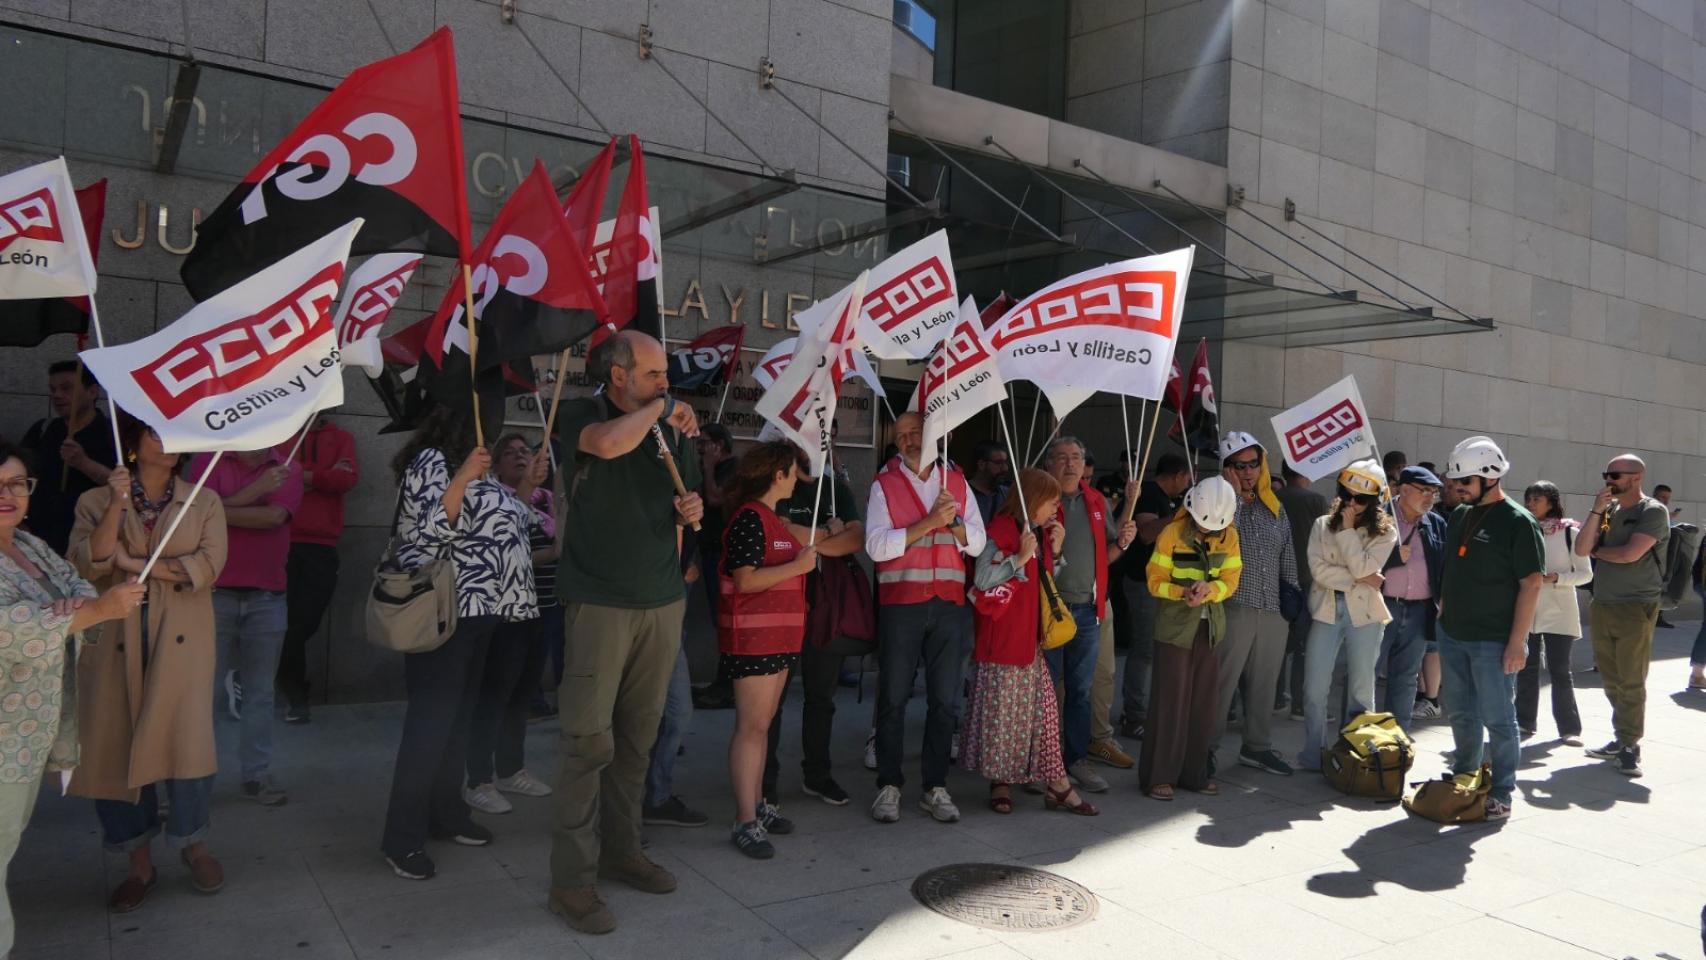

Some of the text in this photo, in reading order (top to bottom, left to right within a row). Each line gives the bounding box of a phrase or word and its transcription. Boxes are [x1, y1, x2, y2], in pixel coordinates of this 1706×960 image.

[922, 310, 955, 330] León
[205, 387, 291, 432] Castilla
[288, 375, 307, 392] y
[951, 388, 961, 402] y
[960, 371, 992, 392] León
[1291, 405, 1357, 456] CCOO
